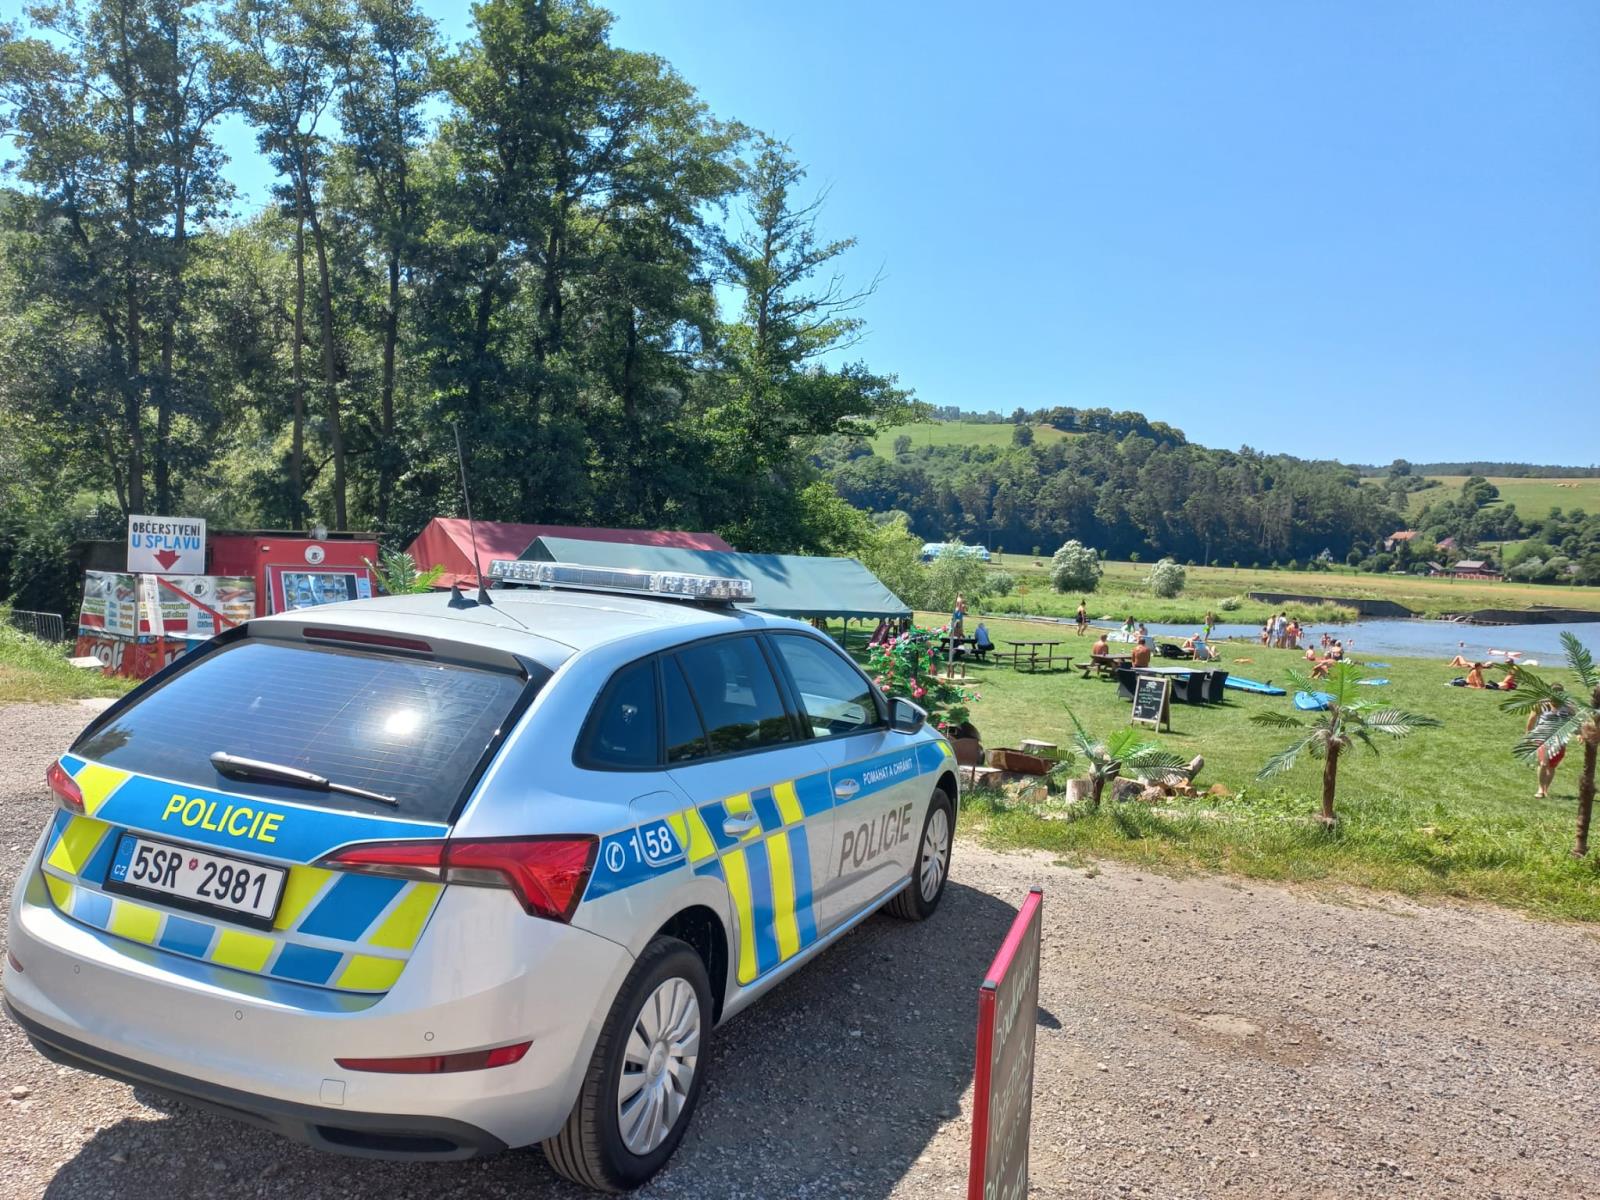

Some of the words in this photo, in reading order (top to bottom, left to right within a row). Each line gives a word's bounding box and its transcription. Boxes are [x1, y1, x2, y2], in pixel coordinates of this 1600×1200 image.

[132, 521, 200, 536] OBČERSTVENÍ
[132, 534, 141, 548] U
[145, 535, 200, 550] SPLAVU
[162, 794, 285, 843] POLICIE
[629, 826, 672, 863] 158
[838, 802, 913, 877] POLICIE
[114, 864, 127, 876] CZ
[133, 846, 182, 888] 5SR
[196, 862, 267, 908] 2981
